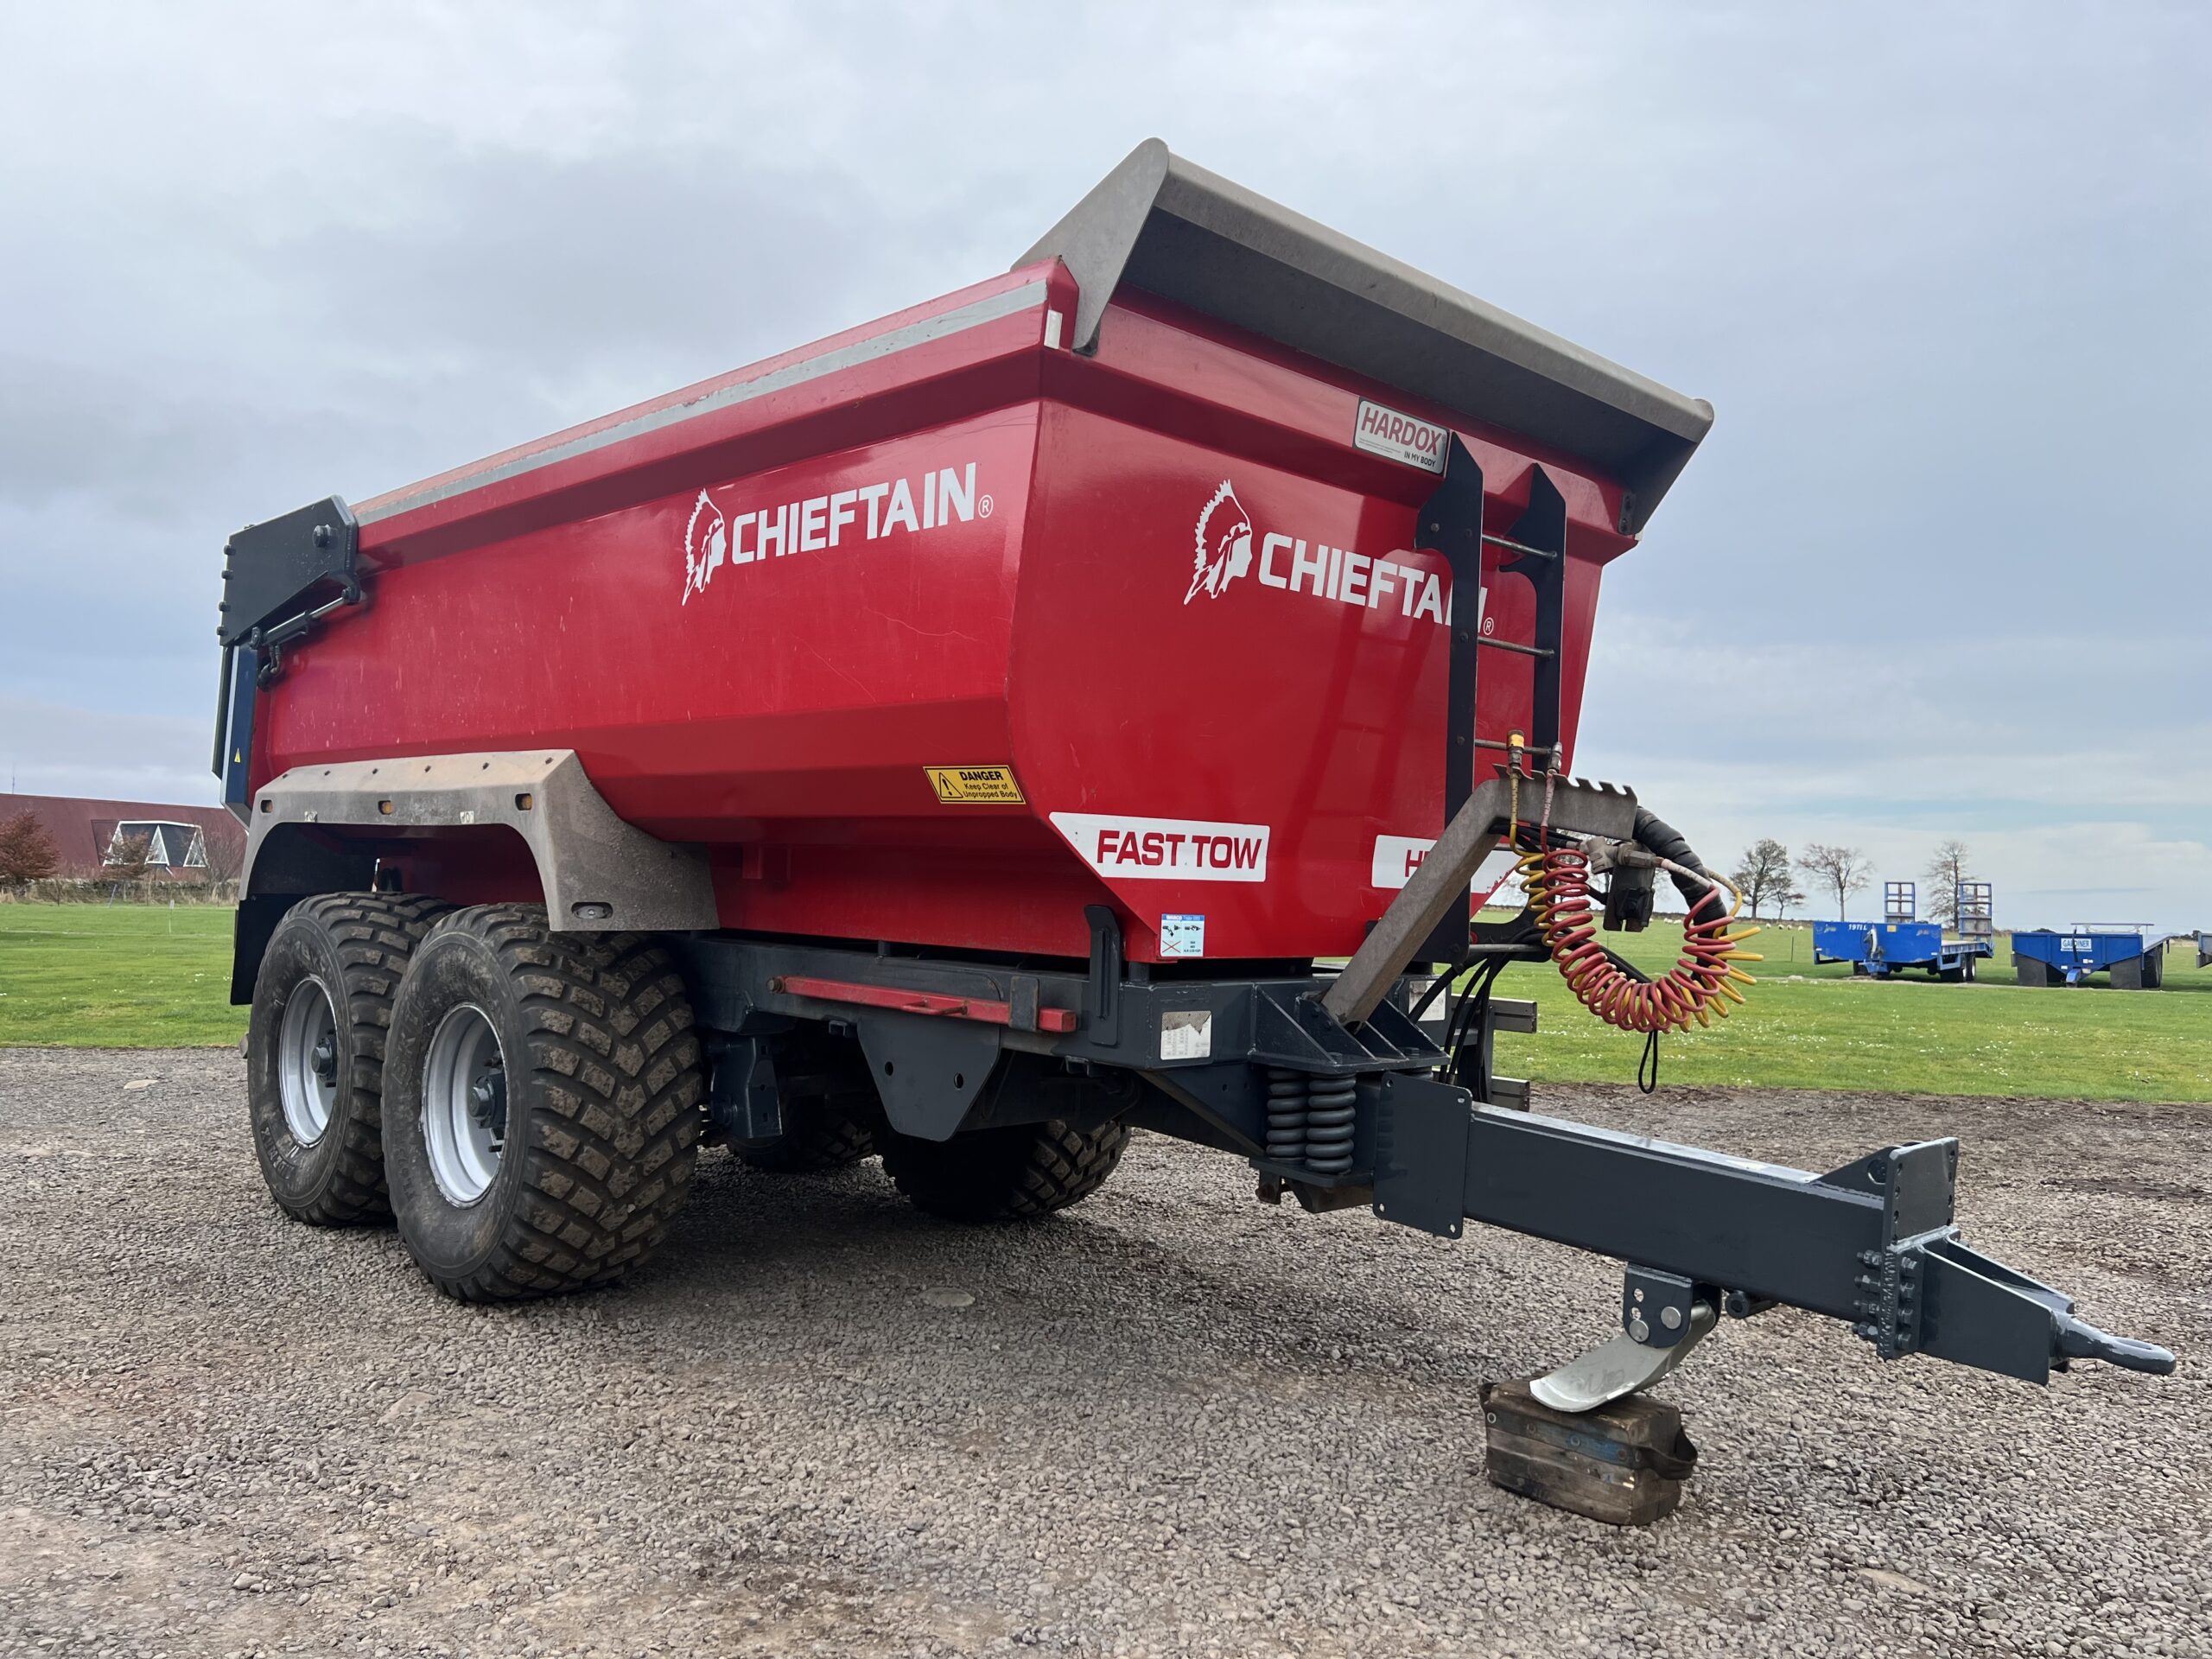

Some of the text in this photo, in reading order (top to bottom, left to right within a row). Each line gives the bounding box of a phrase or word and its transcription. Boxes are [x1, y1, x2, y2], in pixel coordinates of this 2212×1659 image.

[1361, 407, 1442, 455] HARDOX
[1411, 454, 1421, 462] MY
[1420, 457, 1436, 467] BODY
[732, 462, 976, 565] CHIEFTAIN
[1258, 531, 1488, 633] CHIEFTA
[959, 771, 1004, 781] DANGER
[963, 791, 1018, 799] Unpropped Body
[1097, 830, 1262, 869] FAST TOW
[2063, 939, 2090, 948] GADINER
